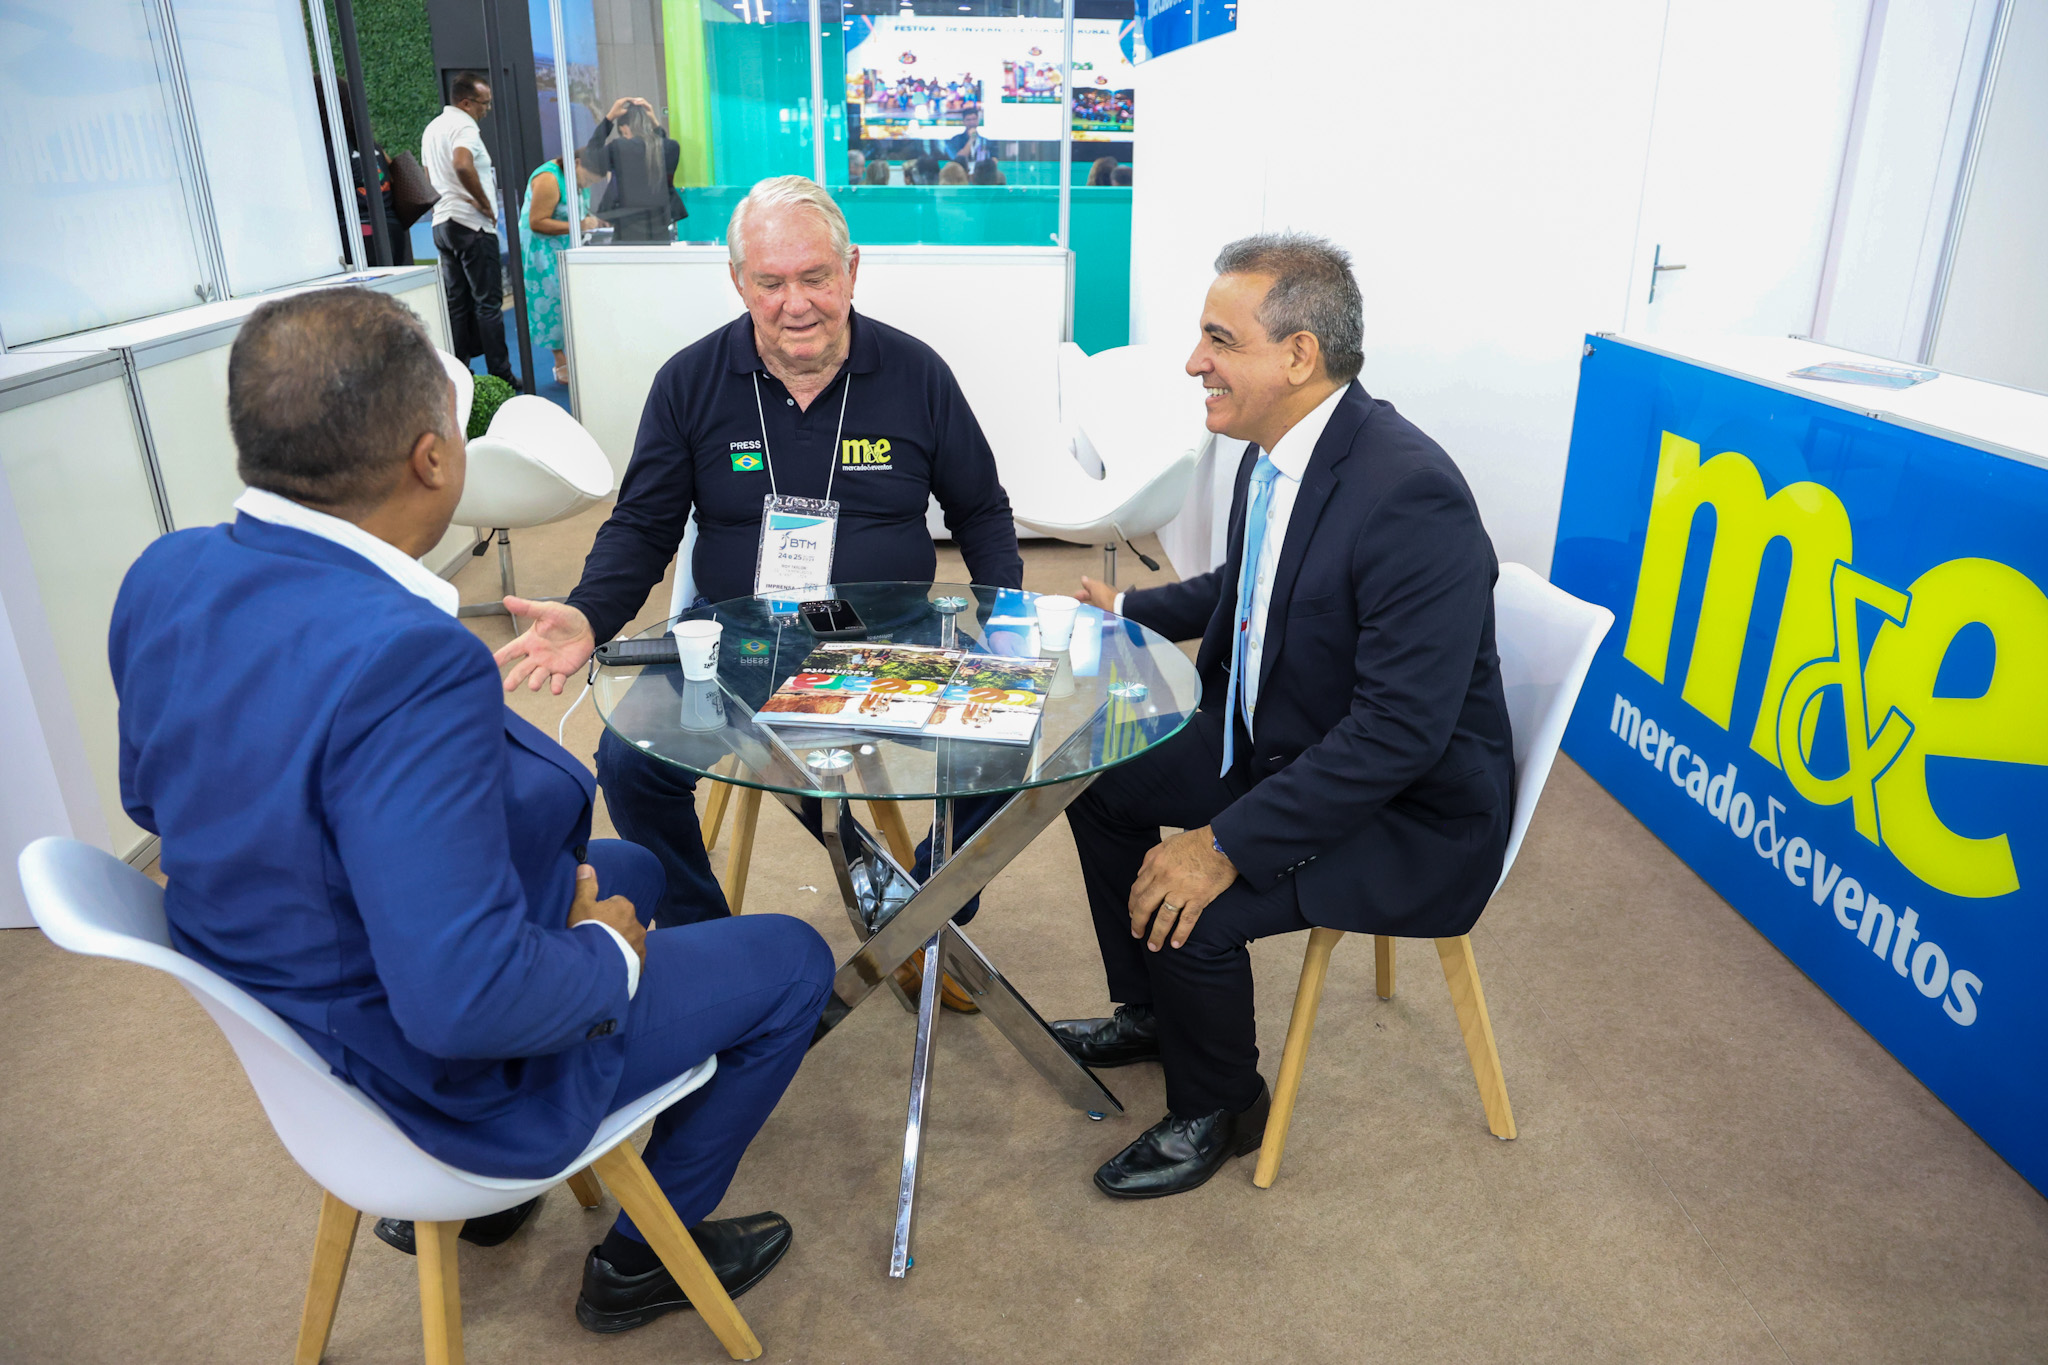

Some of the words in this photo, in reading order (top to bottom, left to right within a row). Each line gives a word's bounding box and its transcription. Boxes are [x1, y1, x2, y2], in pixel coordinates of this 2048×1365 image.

[730, 440, 761, 450] PRESS
[842, 438, 892, 464] m&e
[790, 538, 817, 550] BTM
[802, 667, 873, 677] fascinante
[1622, 430, 2048, 898] m&e
[1610, 693, 1984, 1027] mercado&eventos
